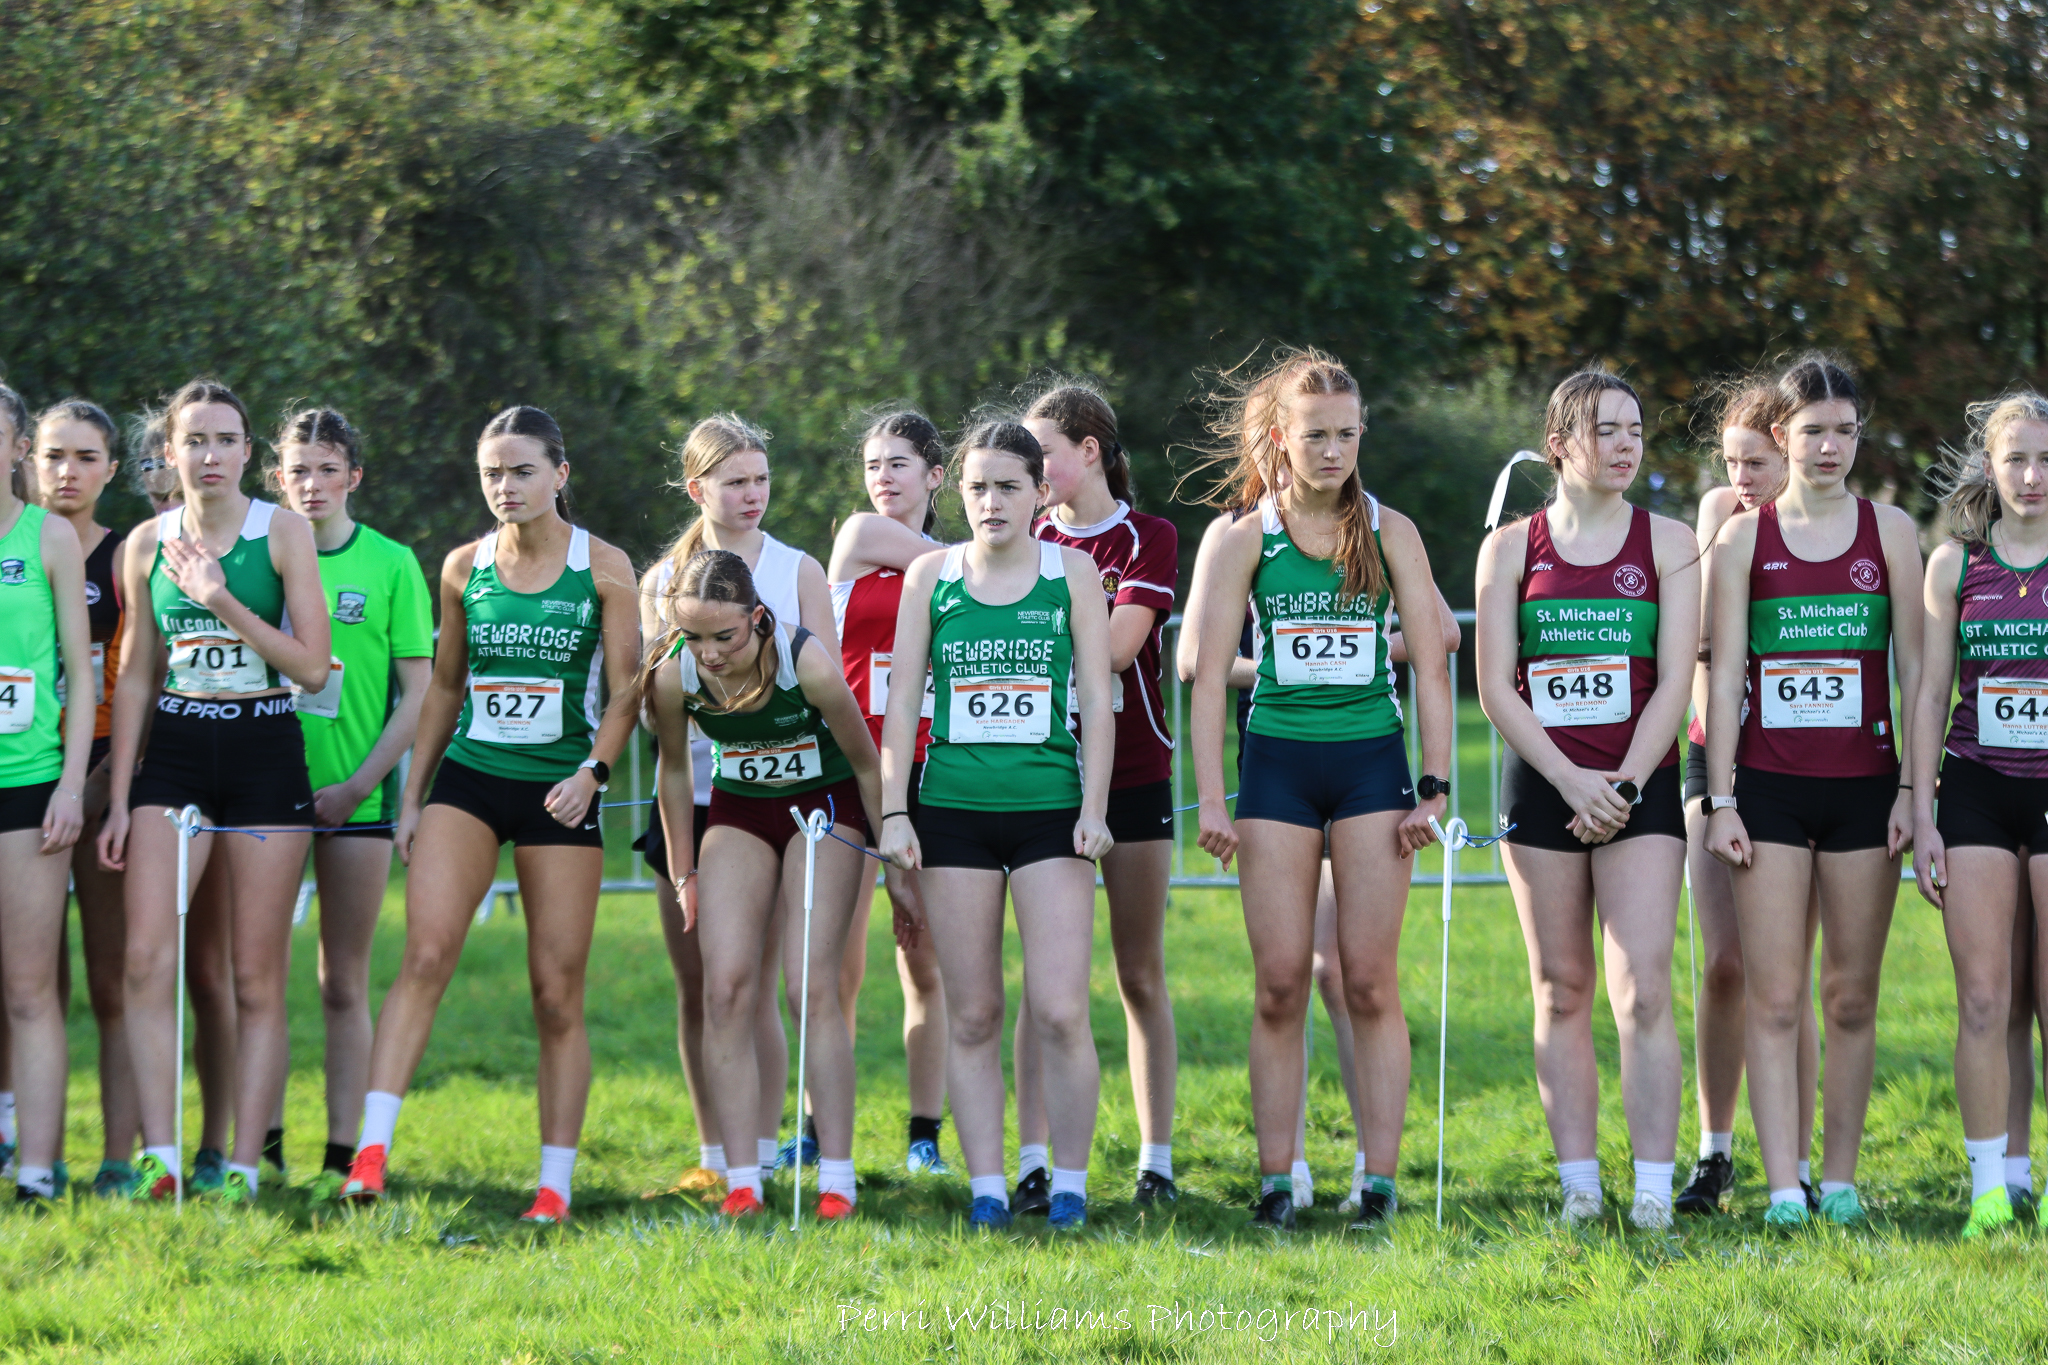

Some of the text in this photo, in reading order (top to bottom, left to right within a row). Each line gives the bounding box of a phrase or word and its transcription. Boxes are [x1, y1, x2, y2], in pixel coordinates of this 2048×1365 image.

[1536, 608, 1632, 622] St. Michael's
[1778, 603, 1869, 620] St. Michael's
[471, 624, 583, 651] NEWBRIDGE
[1540, 628, 1632, 643] Athletic Club
[1780, 623, 1868, 640] Athletic Club
[1966, 624, 1988, 638] ST.
[190, 646, 248, 670] 701
[478, 646, 571, 662] ATHLETIC CLUB
[942, 639, 1055, 664] NEWBRIDGE
[1292, 635, 1358, 660] 625
[1970, 643, 2038, 656] ATHLETIC
[950, 663, 1048, 676] ATHLETIC CLUB
[1548, 673, 1614, 700] 648
[1778, 676, 1844, 702] 643
[182, 701, 242, 720] PRO
[486, 694, 546, 718] 627
[968, 692, 1034, 718] 626
[1995, 696, 2048, 722] 64
[740, 753, 806, 782] 624
